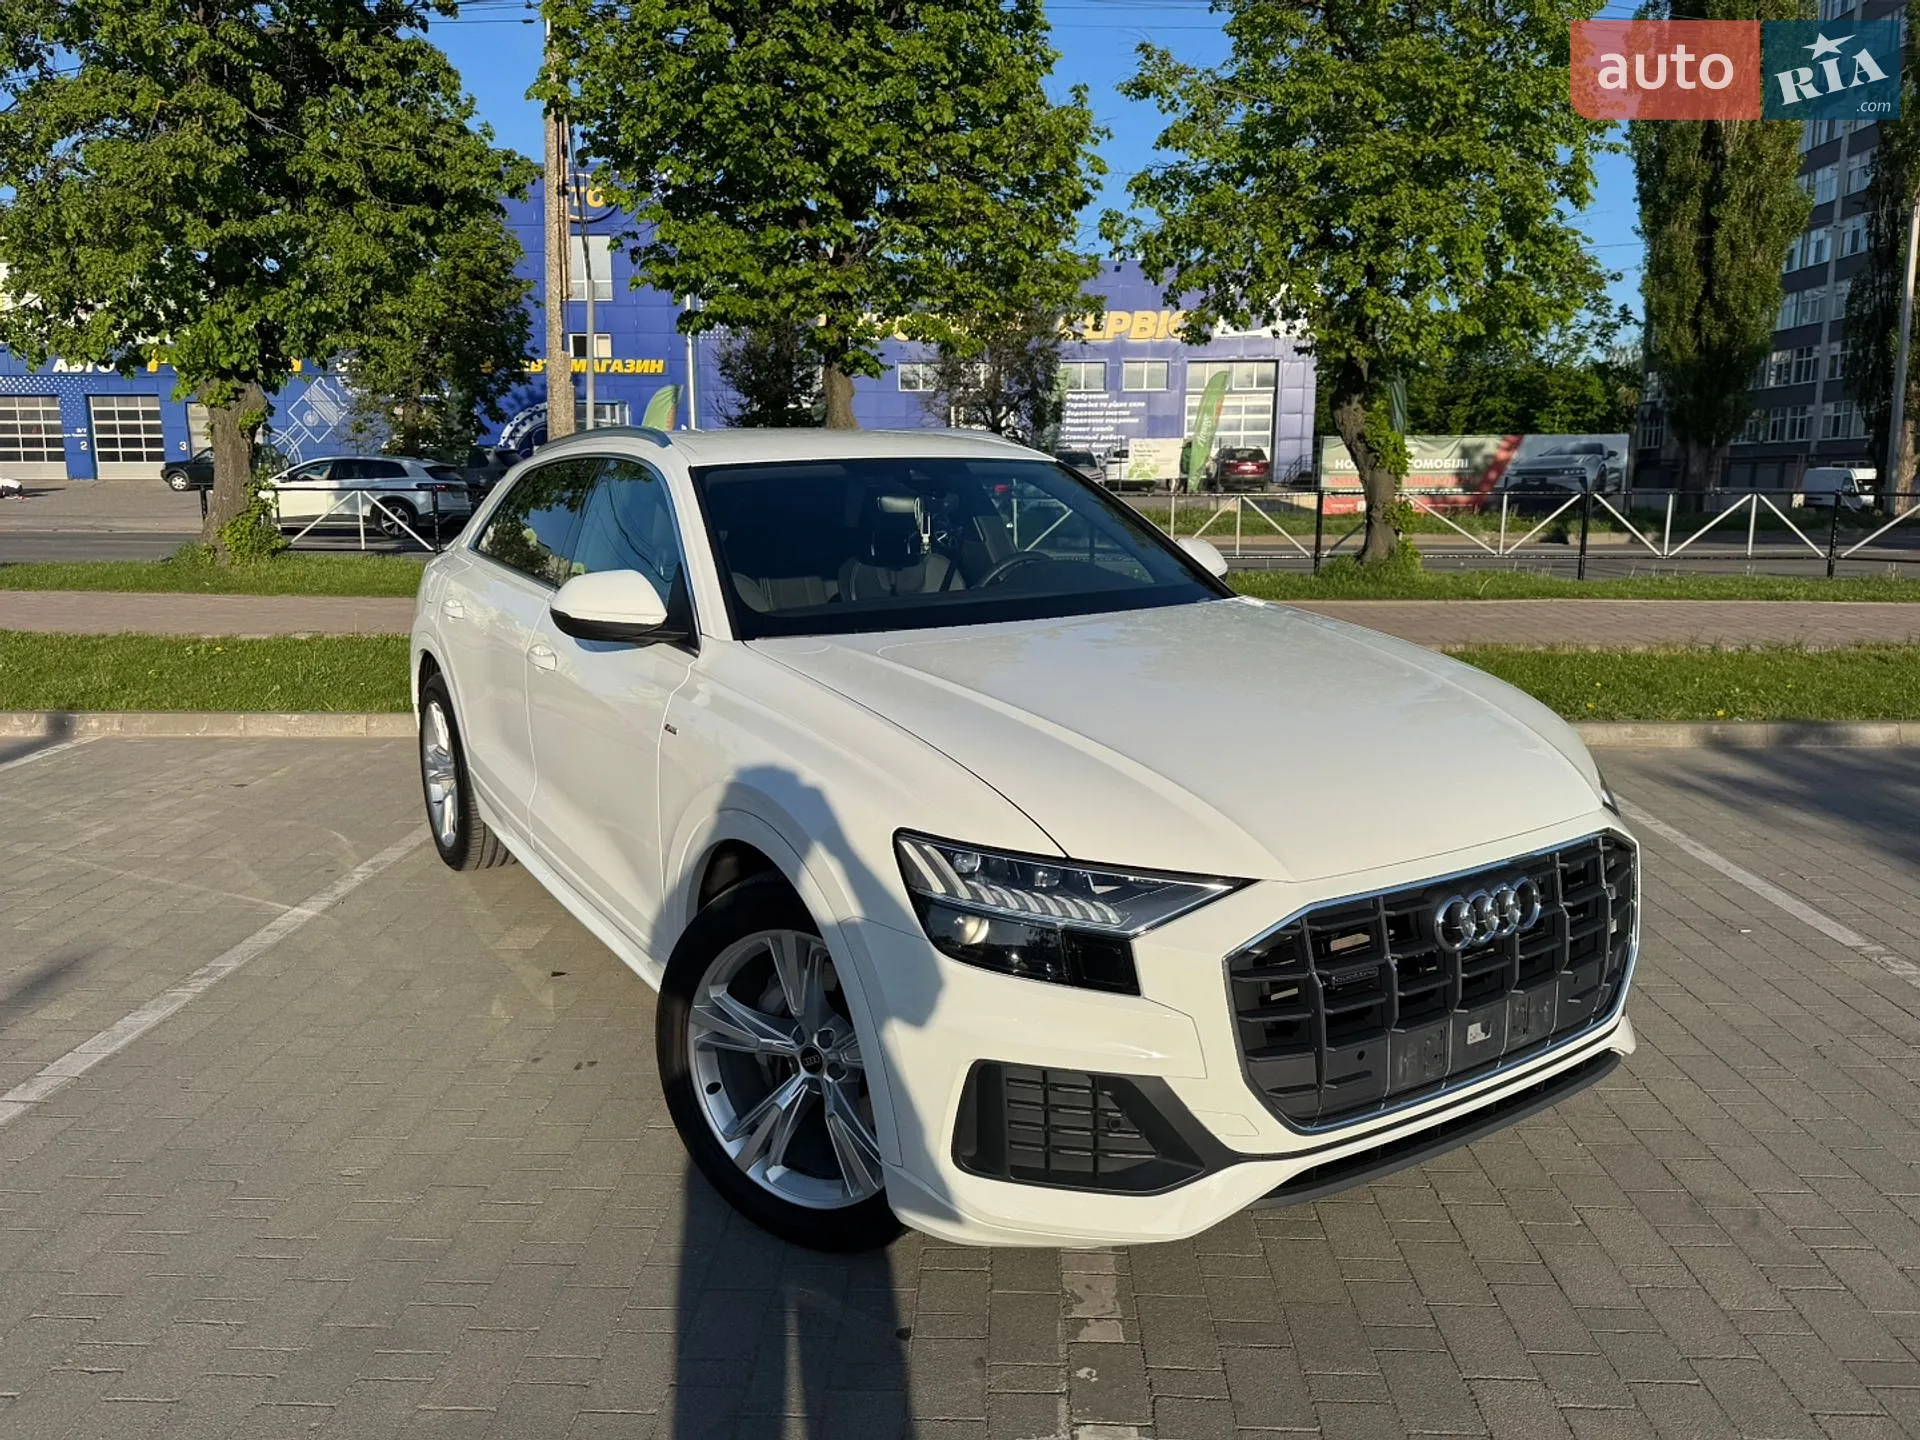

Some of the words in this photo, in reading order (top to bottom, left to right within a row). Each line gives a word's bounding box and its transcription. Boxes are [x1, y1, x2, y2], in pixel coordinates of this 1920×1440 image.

[80, 441, 88, 451] 2
[179, 441, 187, 451] 3
[1409, 458, 1469, 469] ОМОБІЛІ
